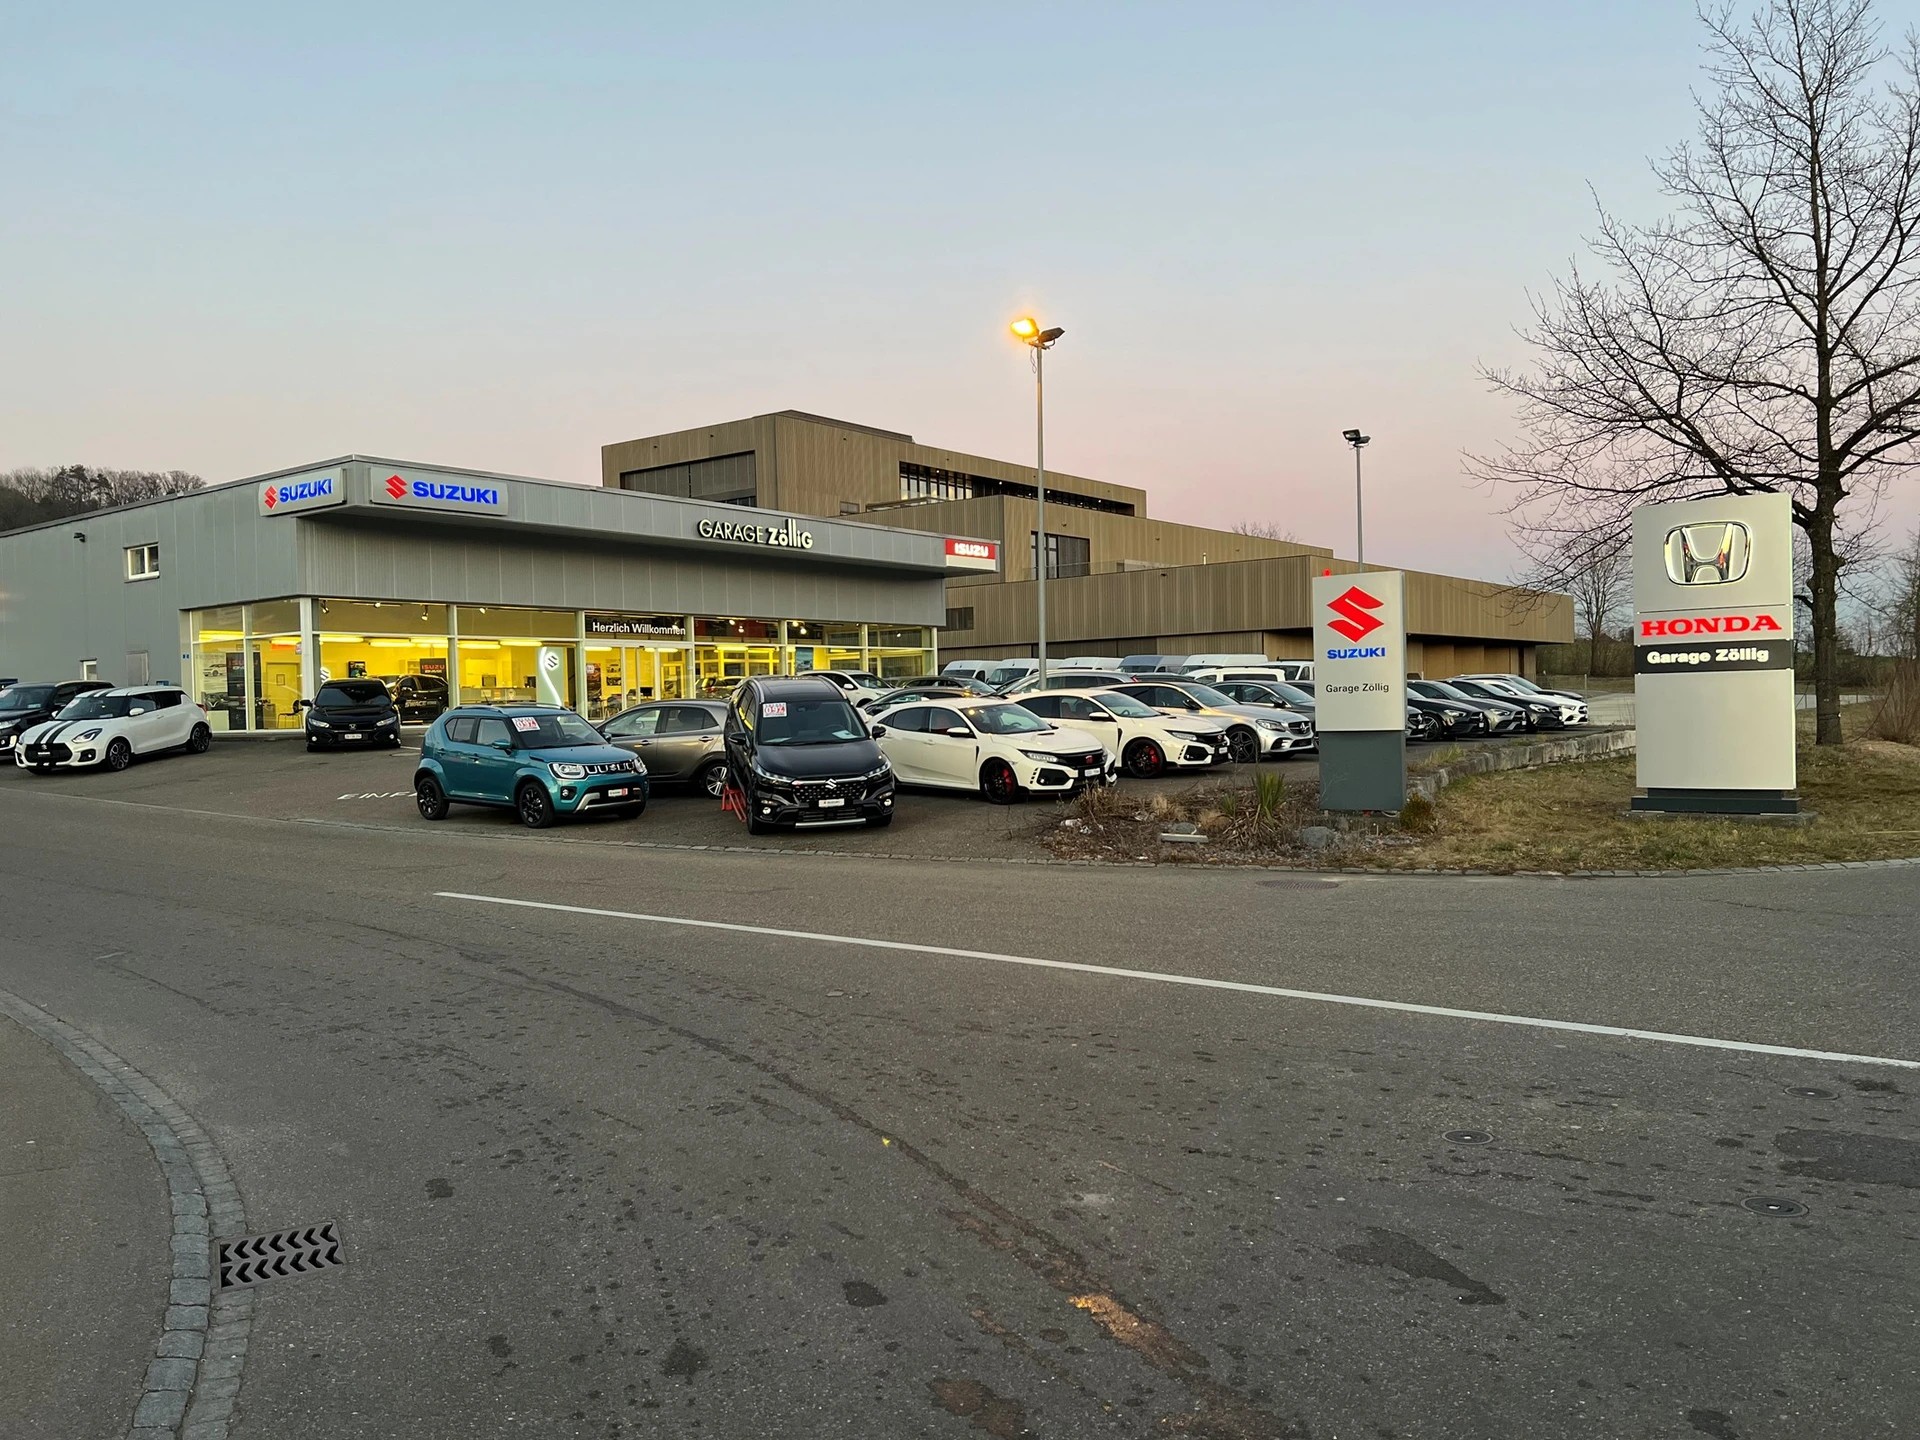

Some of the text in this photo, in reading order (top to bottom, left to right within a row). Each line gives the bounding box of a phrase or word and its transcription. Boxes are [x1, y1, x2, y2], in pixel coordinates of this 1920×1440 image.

[280, 479, 332, 502] SUZUKI
[413, 481, 498, 504] SUZUKI
[698, 519, 764, 543] GARAGE
[954, 542, 989, 557] ISUZU
[592, 622, 686, 635] Herzlich Willkommen
[1641, 615, 1782, 636] HONDA
[1327, 647, 1386, 659] SUZUKI
[1647, 647, 1769, 664] Garage Zöllig
[1325, 682, 1389, 694] Garage Zöllig
